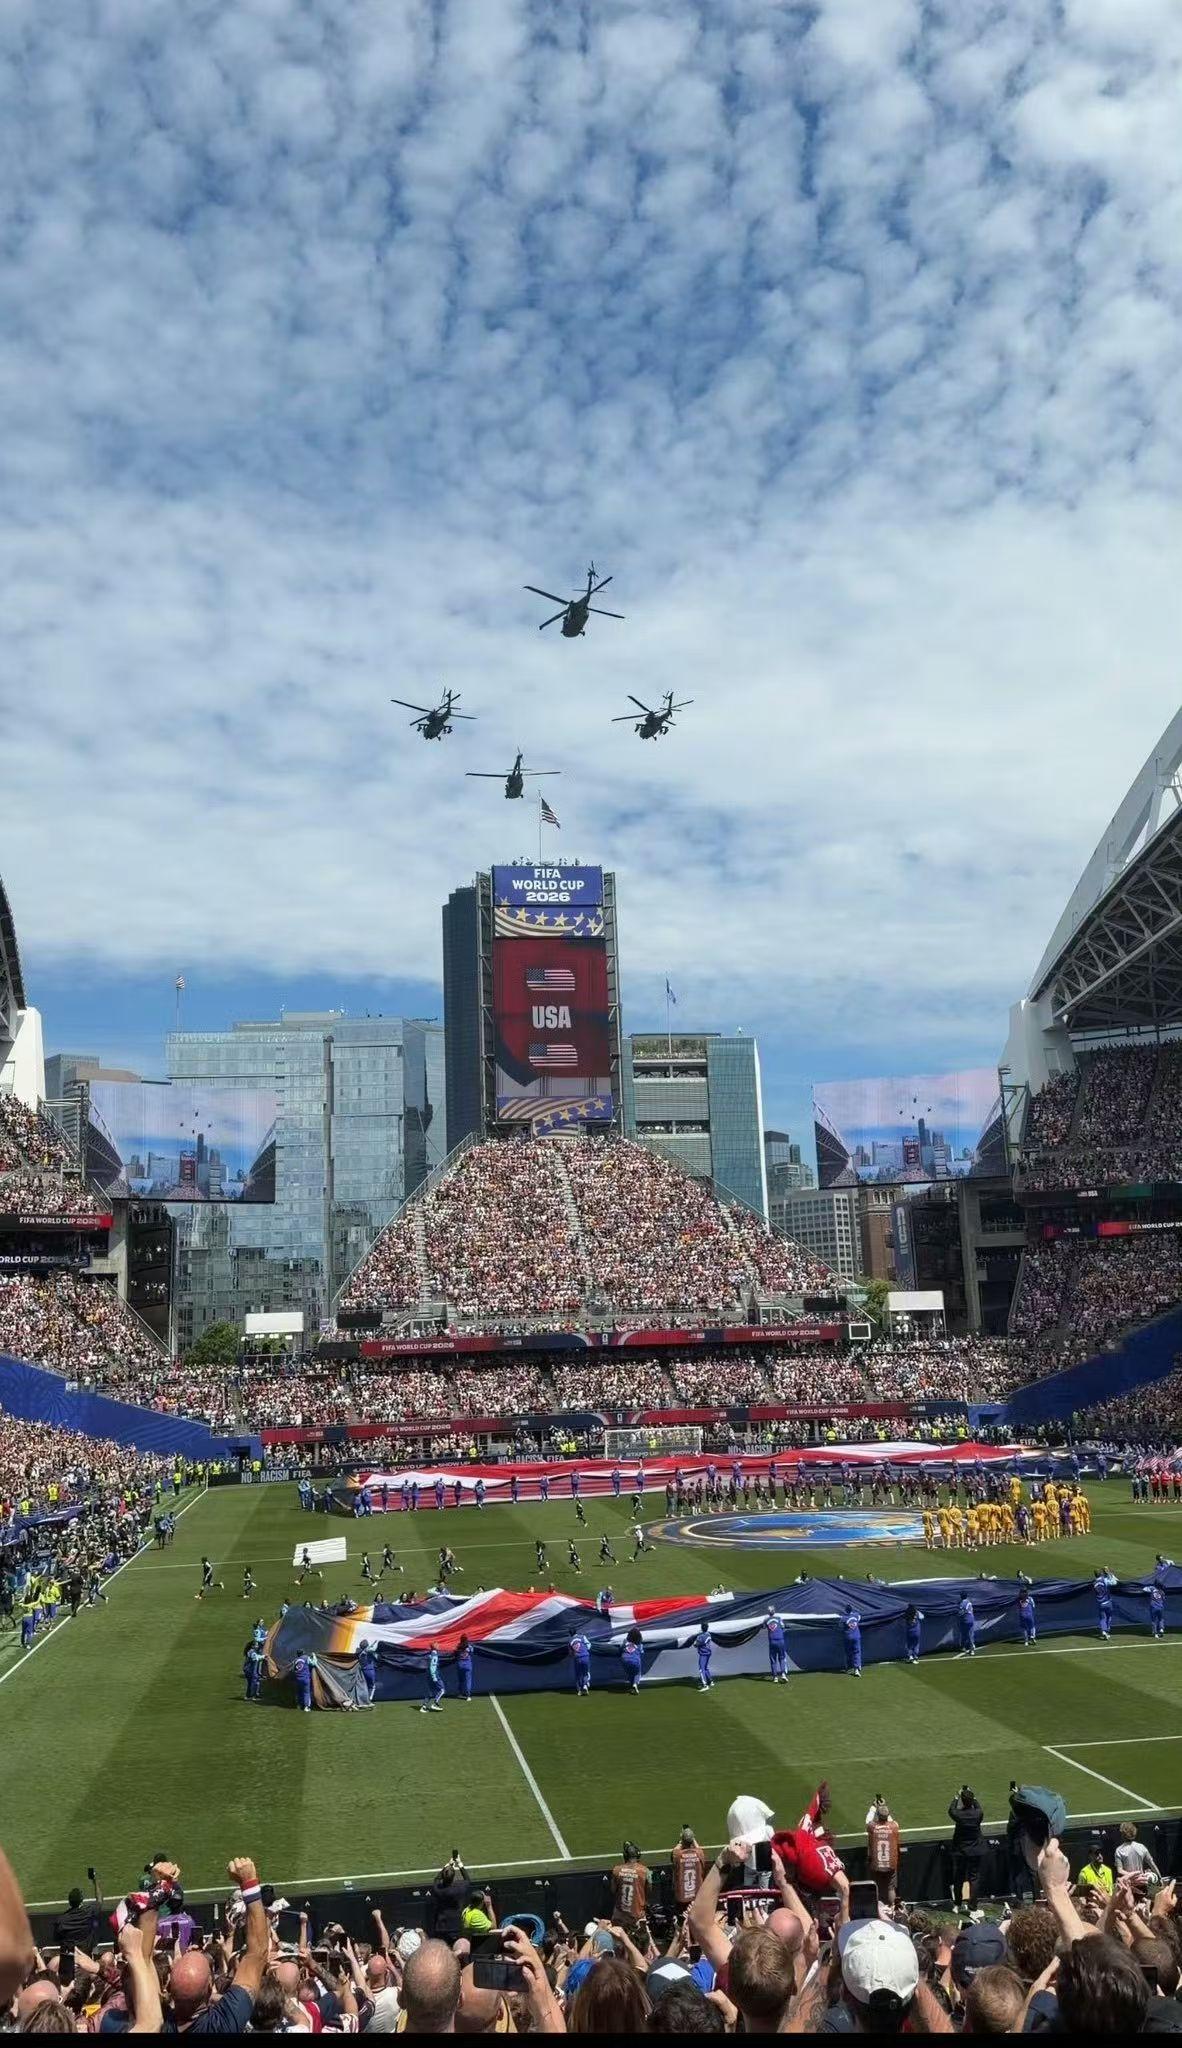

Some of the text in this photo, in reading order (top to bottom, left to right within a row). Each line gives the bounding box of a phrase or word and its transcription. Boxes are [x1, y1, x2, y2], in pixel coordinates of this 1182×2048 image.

[534, 869, 561, 879] FIFA
[512, 880, 585, 890] WORLD CUP
[526, 892, 571, 902] 2026
[532, 1005, 572, 1029] USA
[745, 1444, 773, 1455] RACISM
[515, 1454, 543, 1464] RACISM
[547, 1454, 565, 1463] FIFA
[241, 1469, 311, 1484] NO RACISM FIFA
